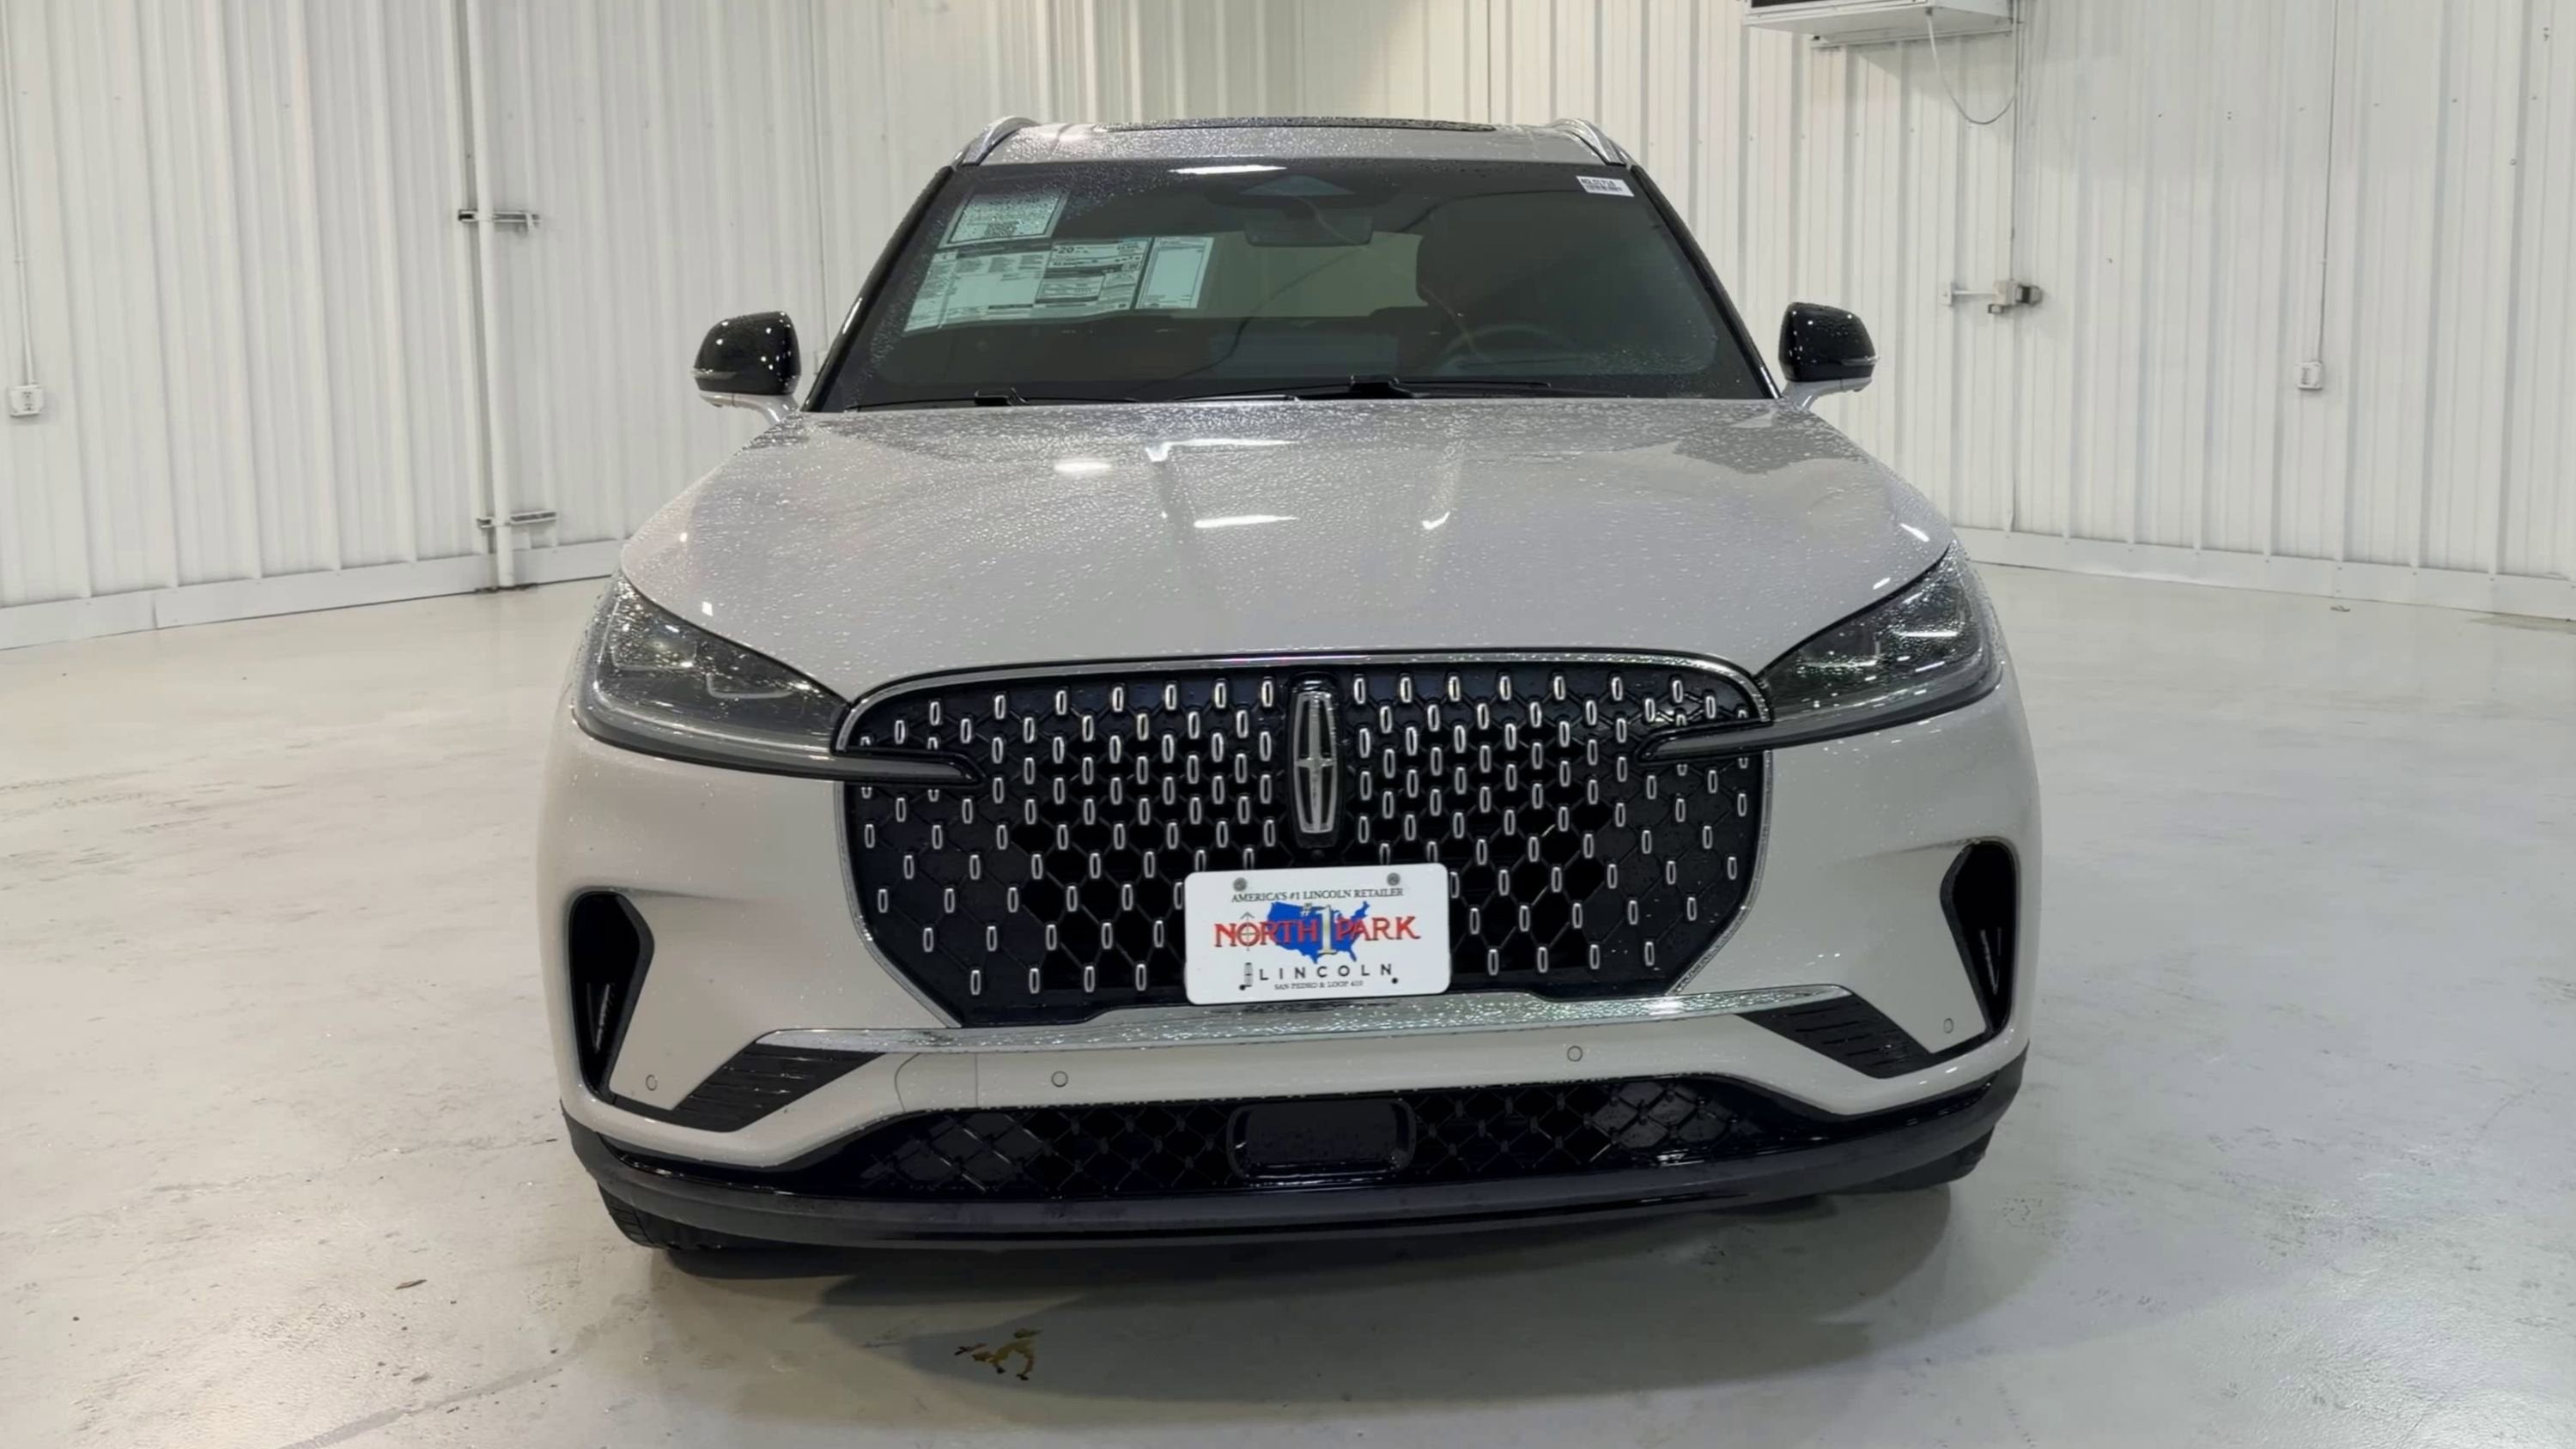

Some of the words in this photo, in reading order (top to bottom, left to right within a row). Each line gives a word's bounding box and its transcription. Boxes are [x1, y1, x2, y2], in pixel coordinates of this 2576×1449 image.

[1231, 892, 1287, 903] AMERICA'S
[1290, 892, 1300, 900] #1
[1303, 890, 1352, 900] LINCOLN
[1354, 888, 1404, 898] RETAILER
[1214, 919, 1319, 948] NORTH
[1334, 915, 1421, 942] PARK
[1259, 963, 1393, 981] LINCOLN
